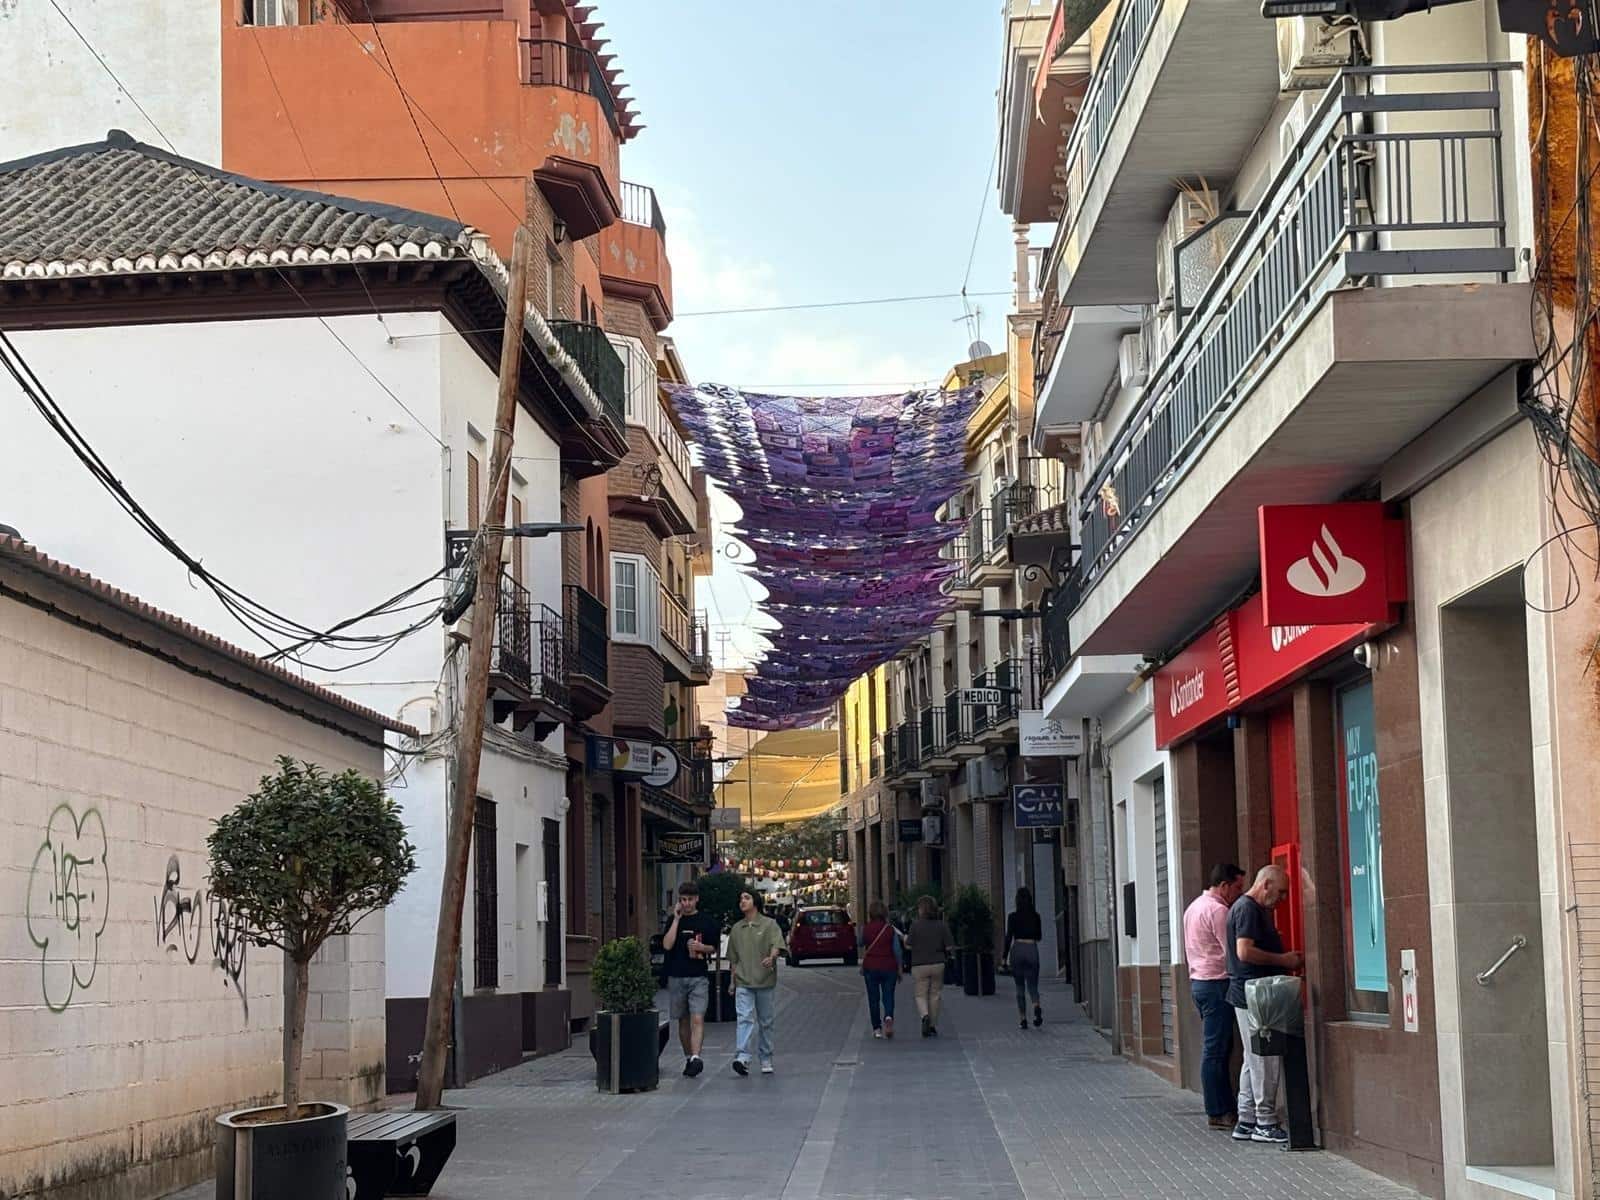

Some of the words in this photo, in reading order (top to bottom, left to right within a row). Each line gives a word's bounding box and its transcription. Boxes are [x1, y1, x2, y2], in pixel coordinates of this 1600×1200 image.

[964, 690, 999, 703] MEDICO
[1176, 667, 1205, 714] Santander
[1346, 726, 1360, 754] MUY
